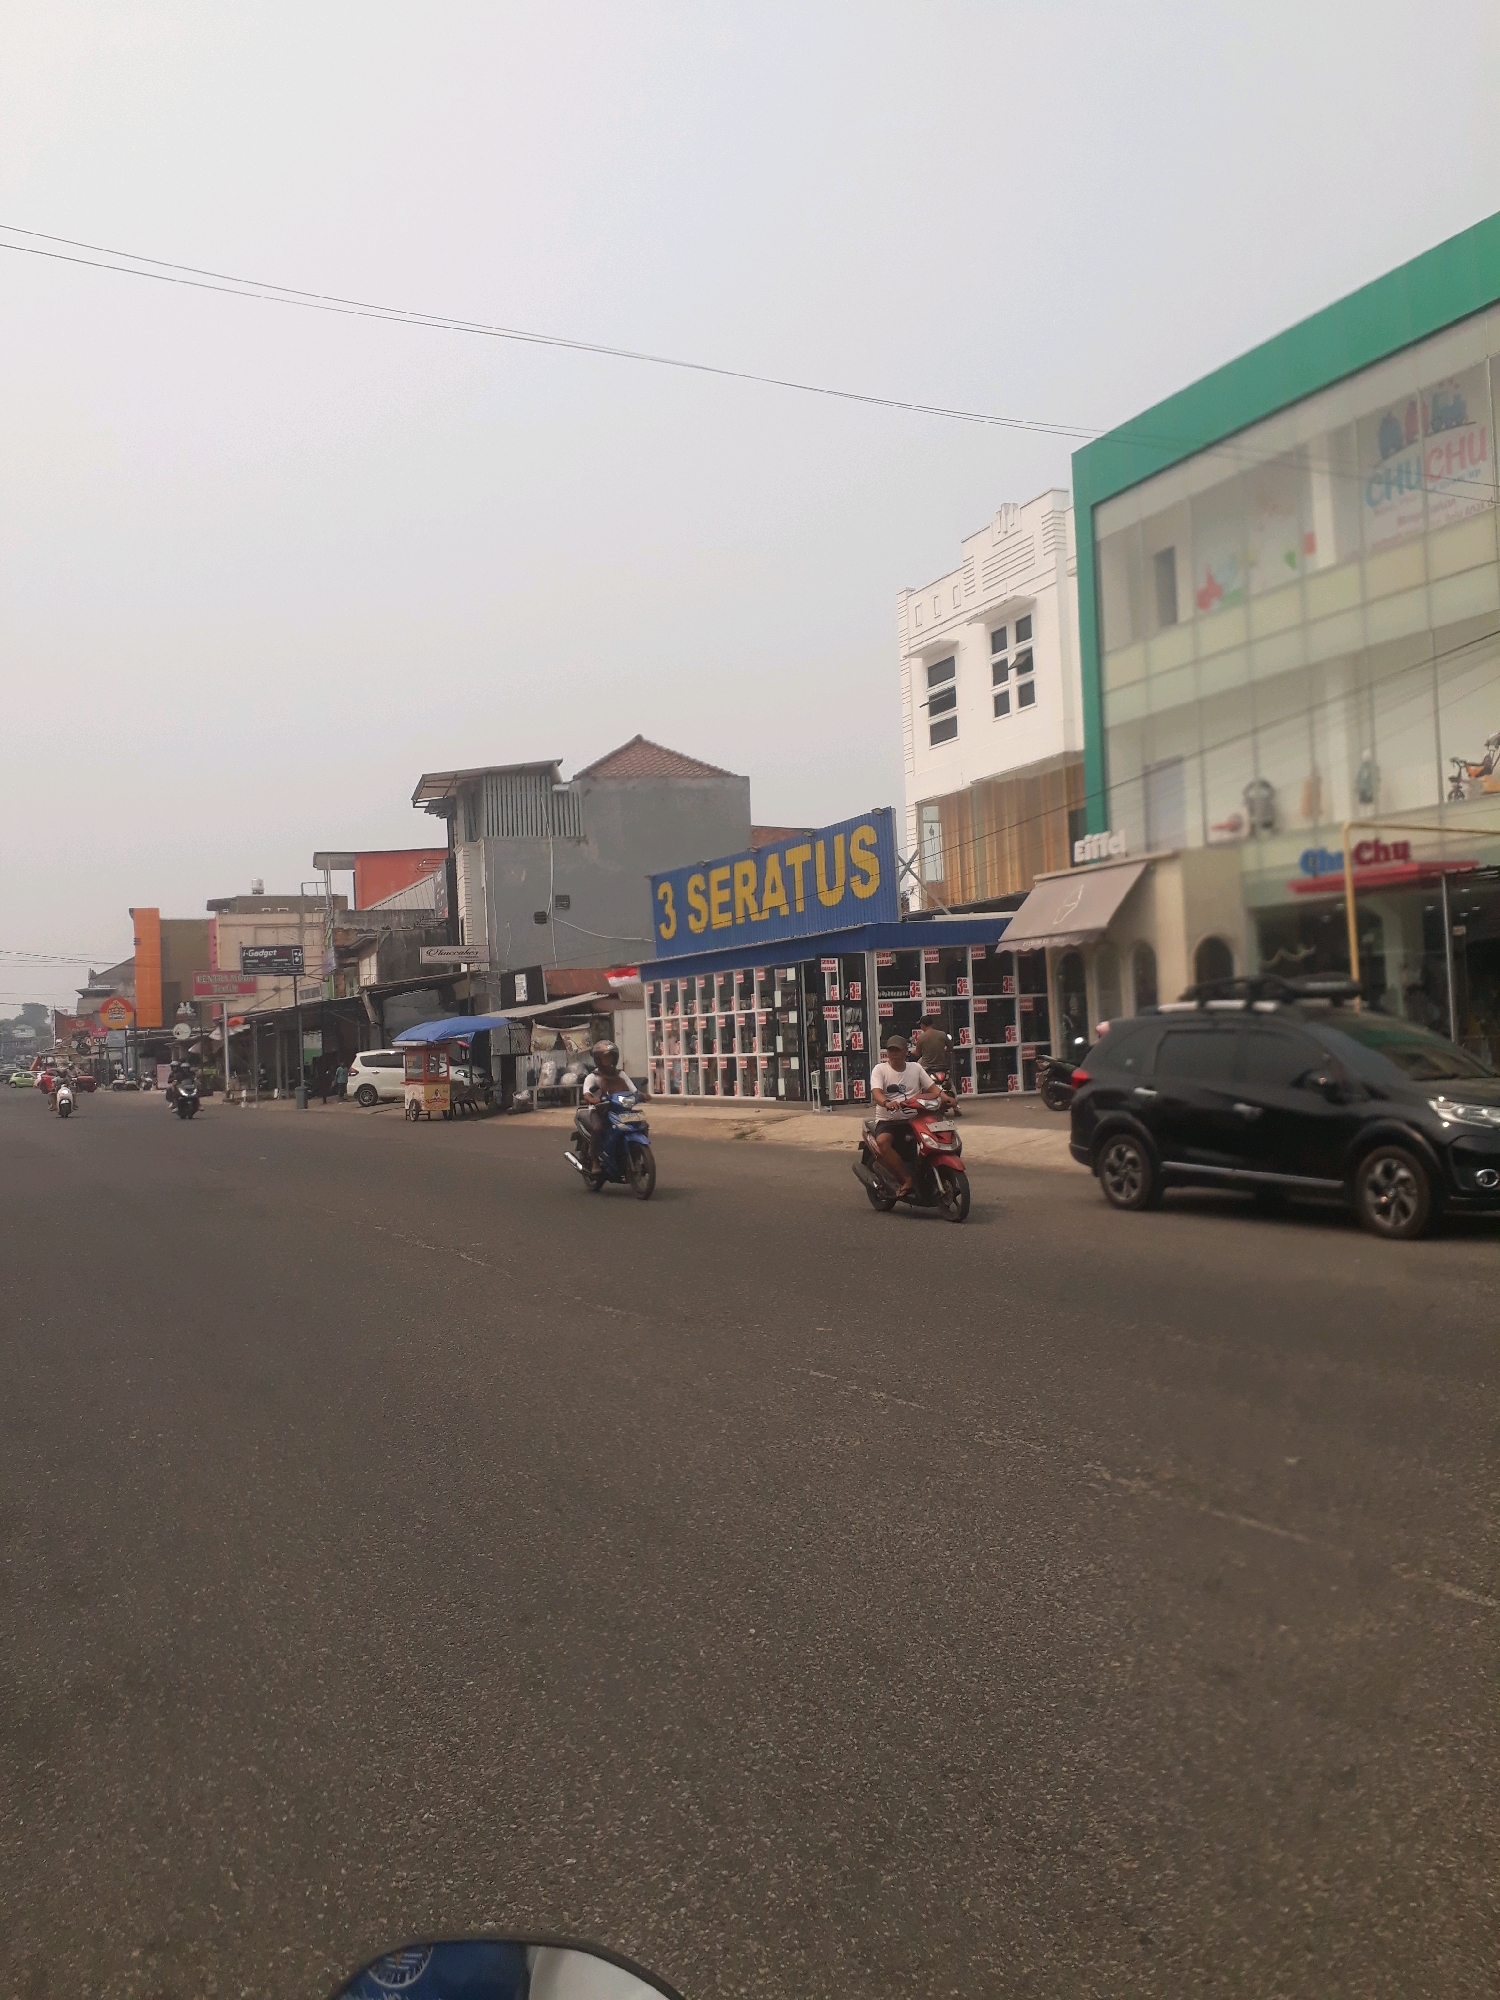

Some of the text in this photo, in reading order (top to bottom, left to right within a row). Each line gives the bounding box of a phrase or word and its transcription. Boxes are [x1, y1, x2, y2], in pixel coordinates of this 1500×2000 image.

[1366, 456, 1422, 507] CHU
[1425, 427, 1487, 482] CHU
[657, 824, 880, 940] 3 SERATUS
[1353, 838, 1411, 865] Chu
